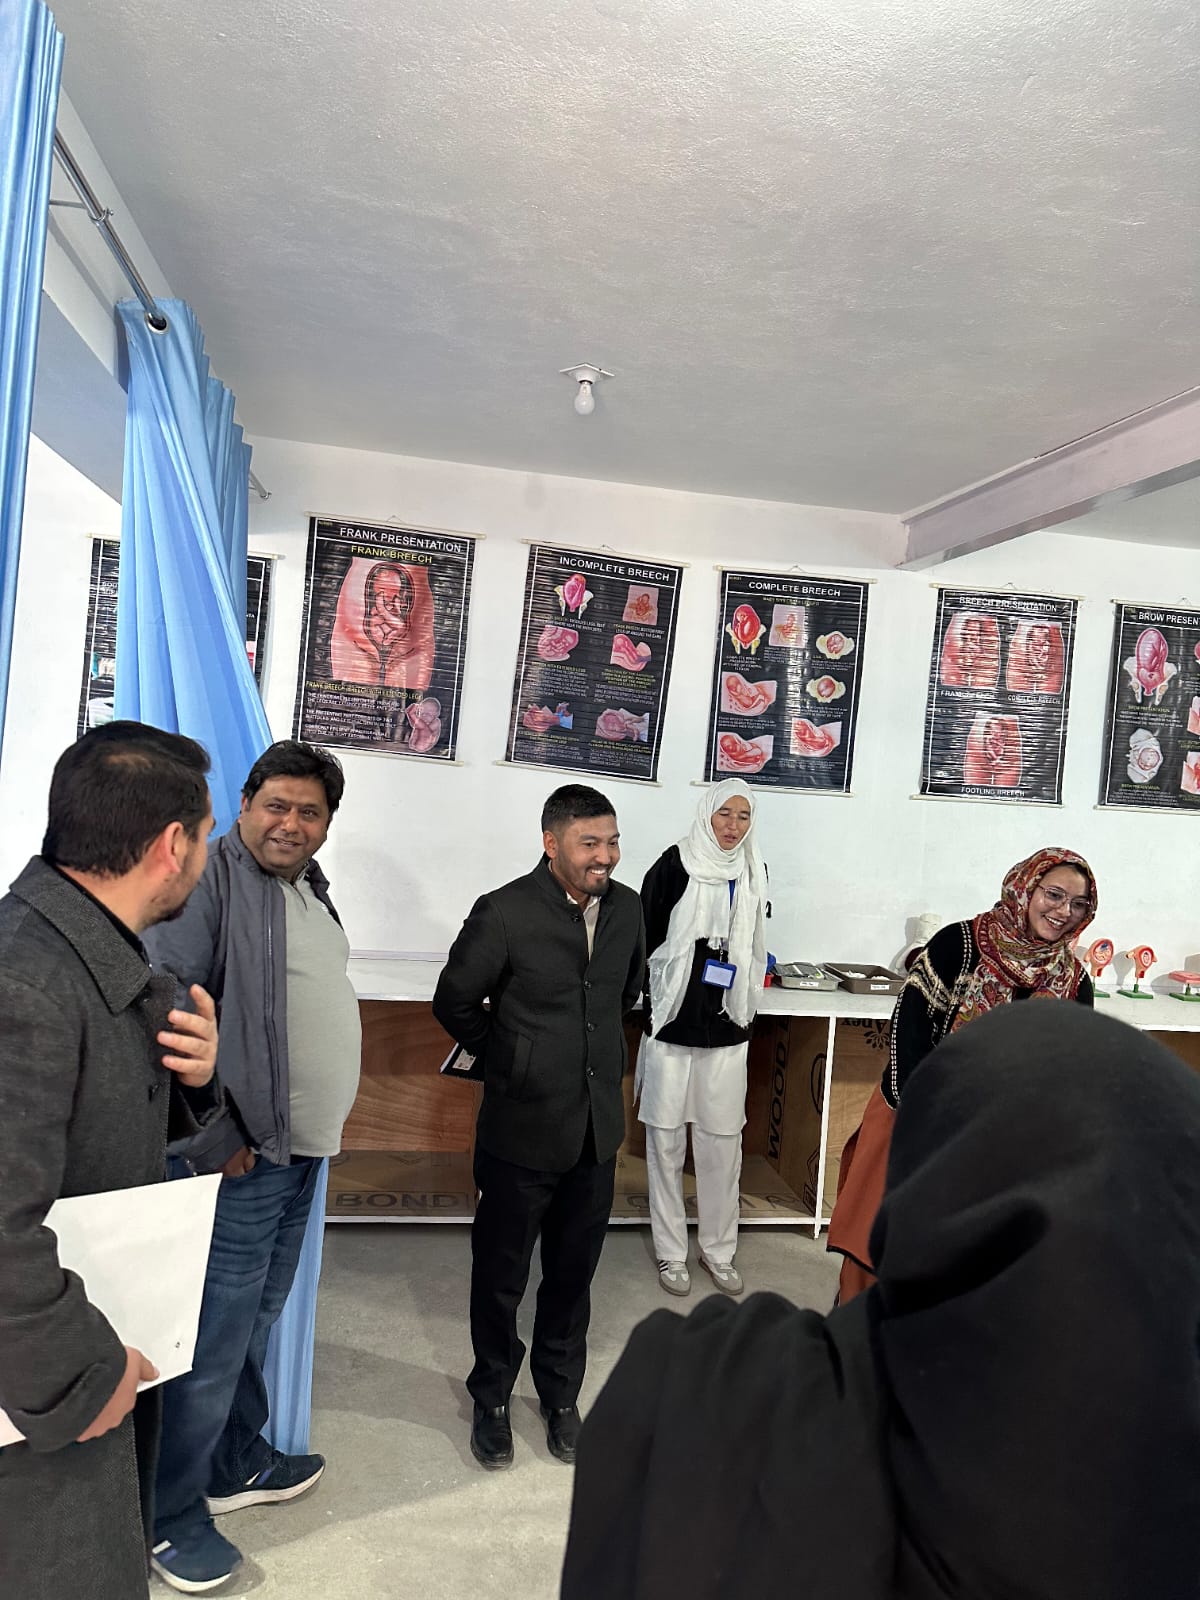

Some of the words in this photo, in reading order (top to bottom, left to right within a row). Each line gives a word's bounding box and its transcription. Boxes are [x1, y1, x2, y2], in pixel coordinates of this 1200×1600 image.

[340, 527, 379, 543] FRANK
[381, 533, 462, 553] PRESENTATION
[560, 556, 625, 575] INCOMPLETE
[628, 567, 671, 582] BREECH
[748, 581, 800, 593] COMPLETE
[801, 585, 842, 597] BREECH
[1138, 611, 1165, 622] BROW
[767, 1041, 788, 1160] WOOD
[335, 1193, 459, 1208] BOND
